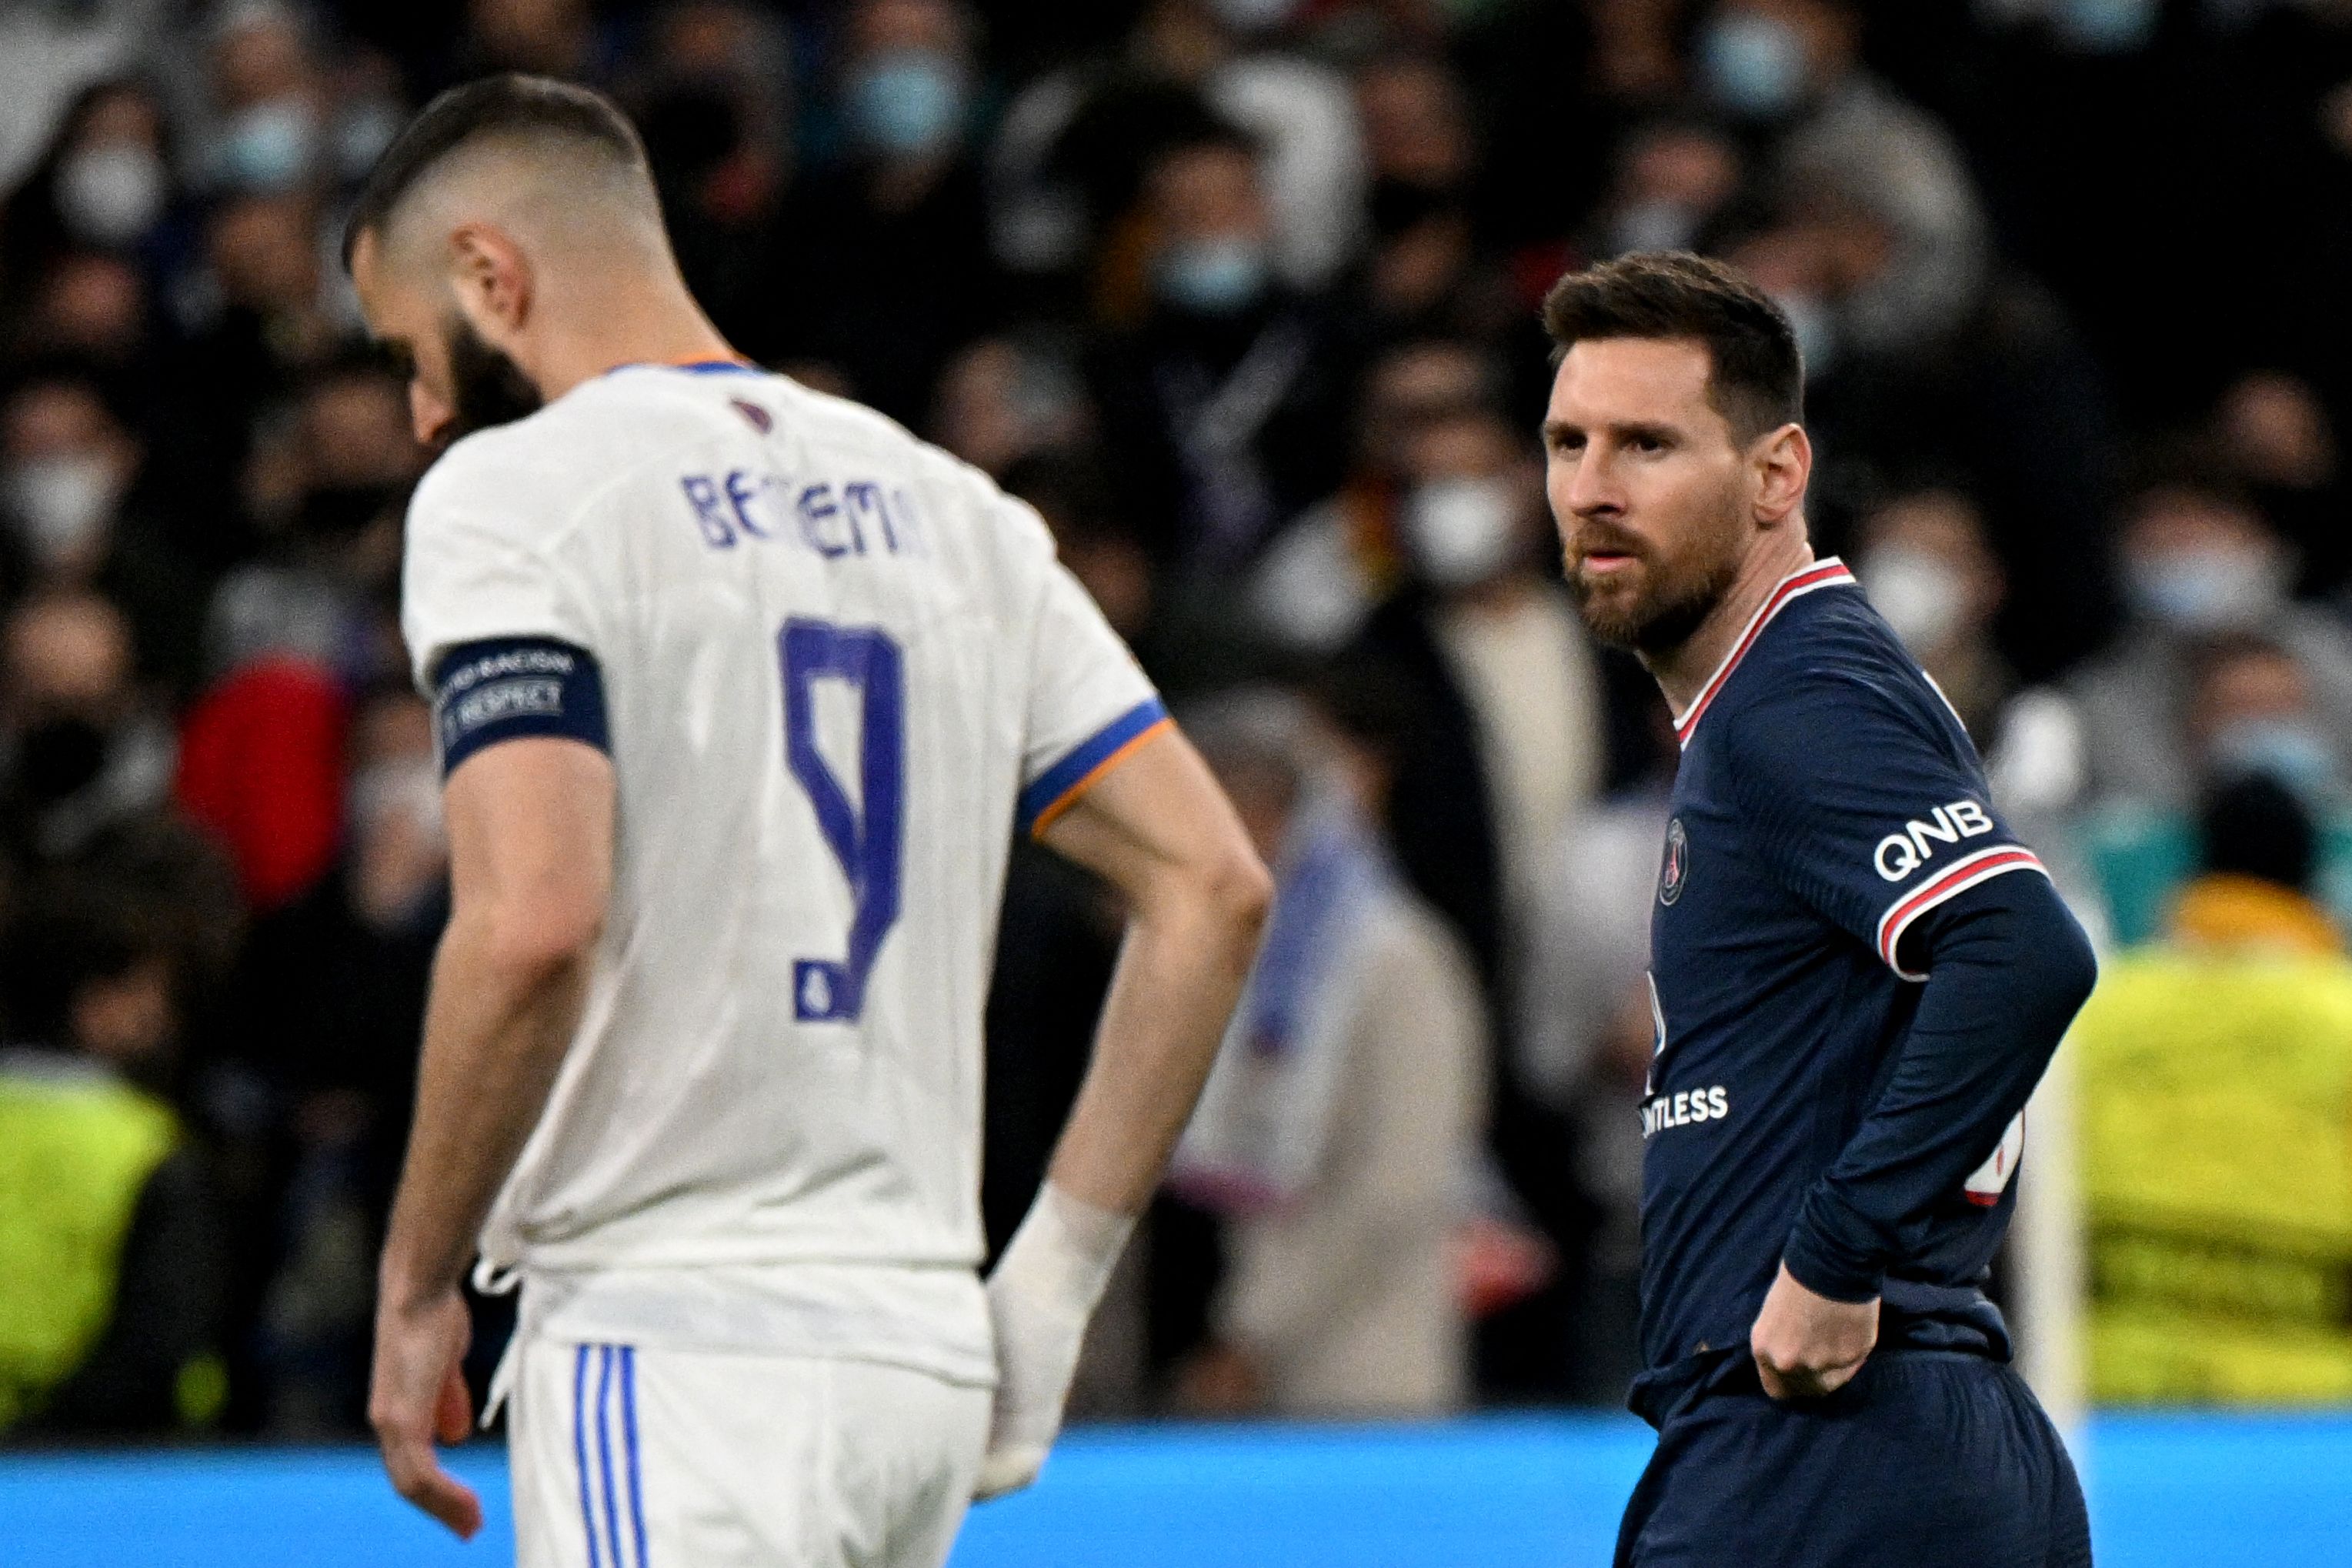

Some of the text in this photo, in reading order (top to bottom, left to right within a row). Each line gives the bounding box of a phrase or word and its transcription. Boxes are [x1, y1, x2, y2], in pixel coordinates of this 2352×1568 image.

[680, 469, 926, 561] BEEM
[776, 616, 905, 1025] 9
[1874, 801, 1994, 882] QNB
